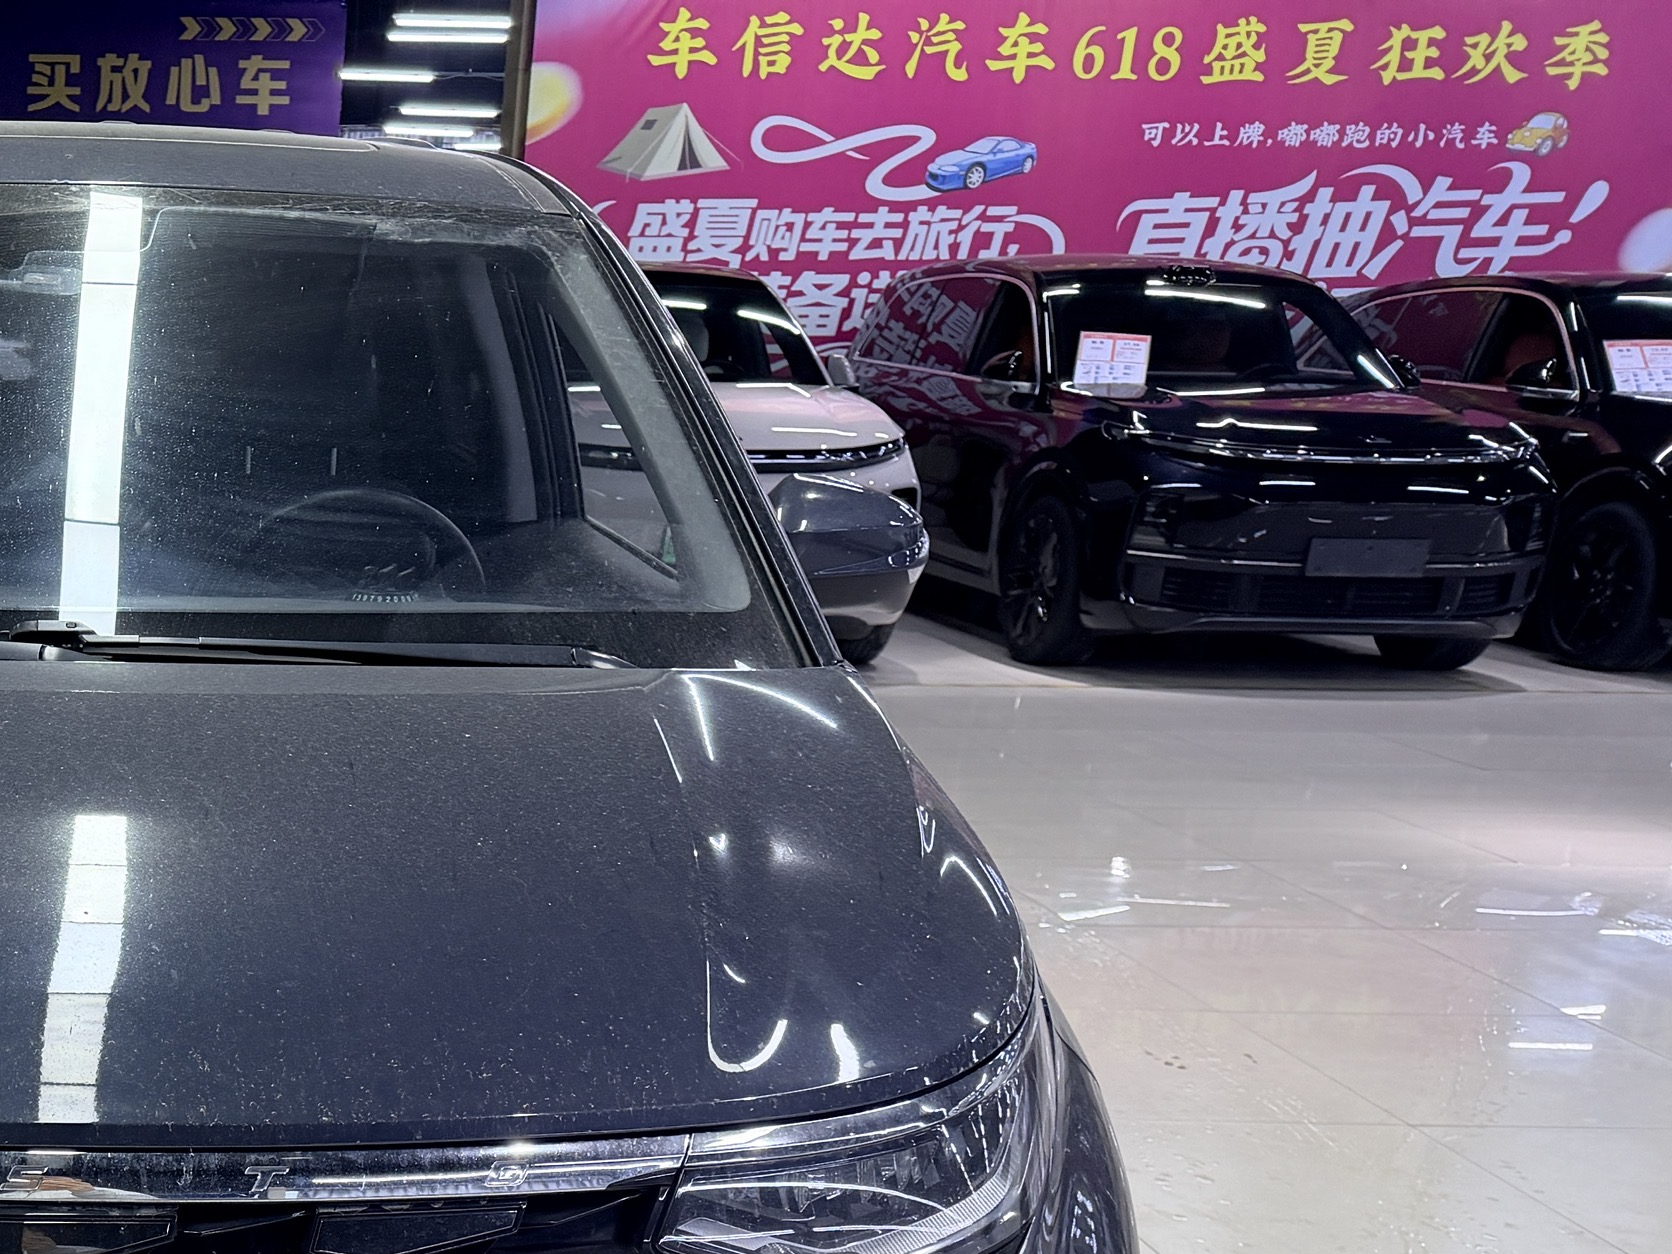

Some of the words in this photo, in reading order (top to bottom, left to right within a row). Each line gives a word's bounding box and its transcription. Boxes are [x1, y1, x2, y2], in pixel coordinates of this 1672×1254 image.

[27, 53, 290, 115] 买放心车
[647, 7, 1611, 90] 车信达汽车618盛夏狂欢季
